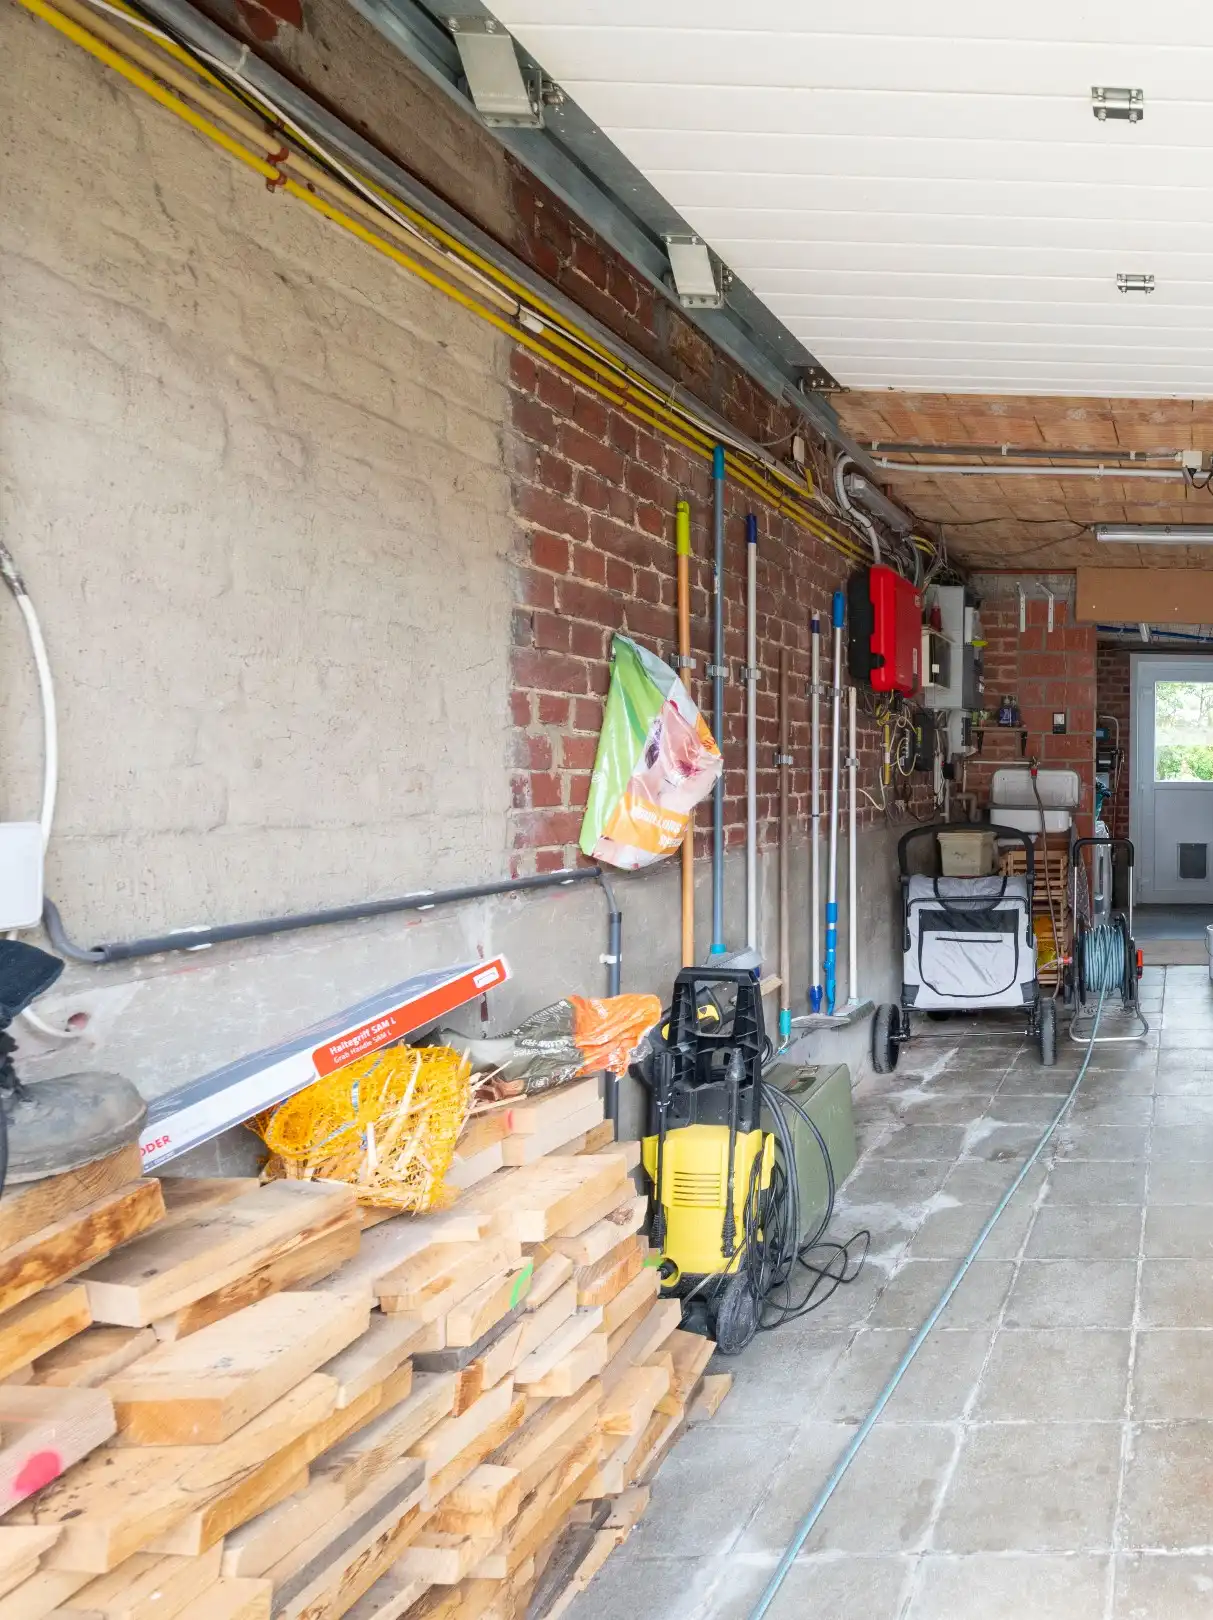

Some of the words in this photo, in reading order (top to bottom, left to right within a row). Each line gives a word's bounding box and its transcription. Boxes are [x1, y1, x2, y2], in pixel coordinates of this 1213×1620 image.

[329, 1029, 371, 1056] Haltegriff
[371, 1018, 390, 1035] SAM
[333, 1051, 350, 1064] Grab
